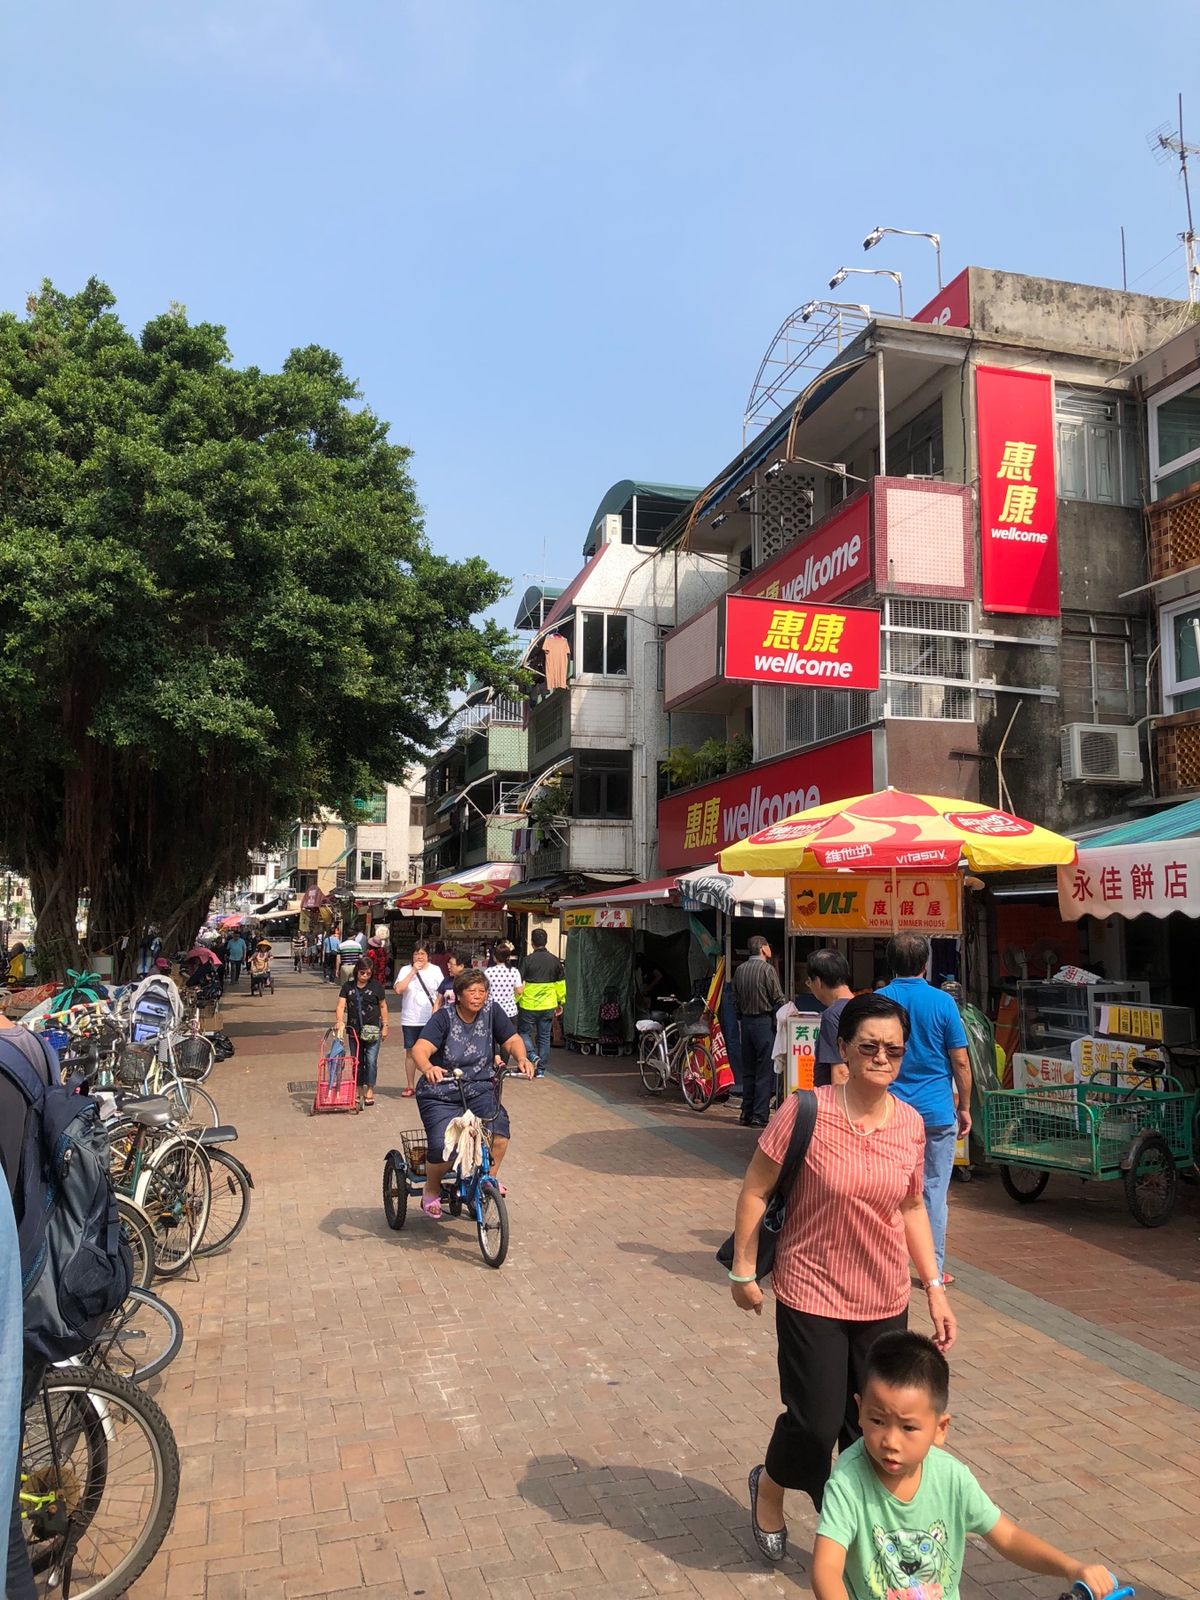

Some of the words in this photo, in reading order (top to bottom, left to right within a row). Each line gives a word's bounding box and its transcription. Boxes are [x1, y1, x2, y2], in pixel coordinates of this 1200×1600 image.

[997, 441, 1038, 526] 惠康
[991, 527, 1048, 543] wellcome
[762, 610, 846, 654] 惠康
[754, 653, 853, 679] wellcome
[684, 797, 721, 849] 惠康
[825, 844, 872, 863] 維他奶
[896, 849, 945, 864] vitasoy
[1072, 861, 1188, 901] 永佳餅店
[872, 900, 942, 917] 度假屋
[898, 919, 923, 927] UMMER
[923, 919, 945, 928] HOUSE
[1041, 1058, 1063, 1084] 長洲
